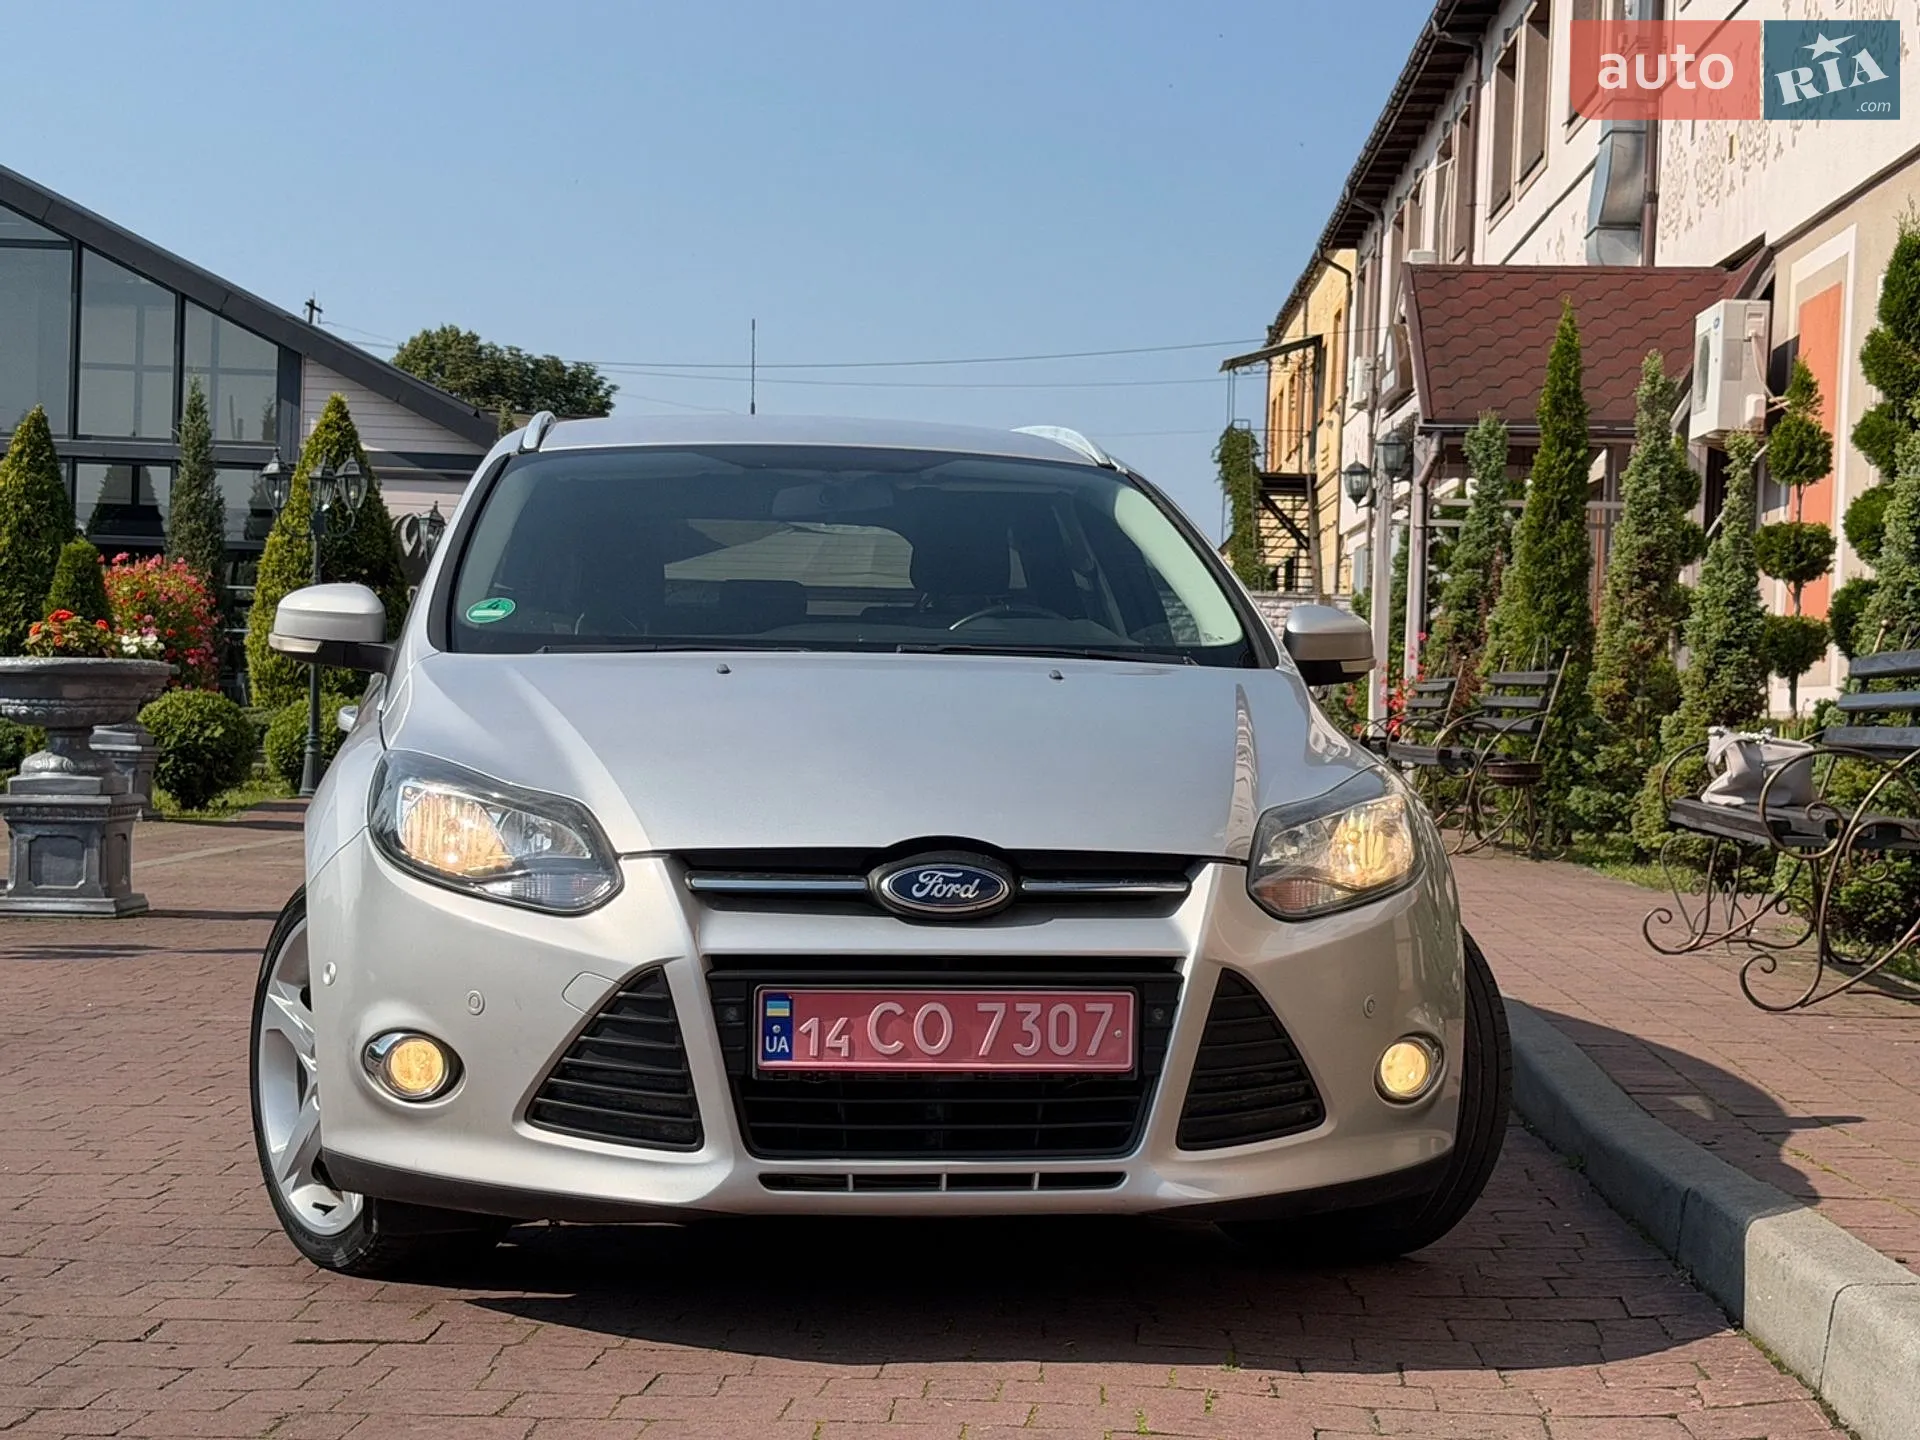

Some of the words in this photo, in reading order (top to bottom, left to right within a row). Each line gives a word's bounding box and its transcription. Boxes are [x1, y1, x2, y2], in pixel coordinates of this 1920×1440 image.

[911, 870, 981, 899] Ford
[799, 1017, 851, 1058] 14
[866, 1001, 954, 1056] CO
[975, 1002, 1115, 1057] 7307
[765, 1035, 789, 1054] UA
